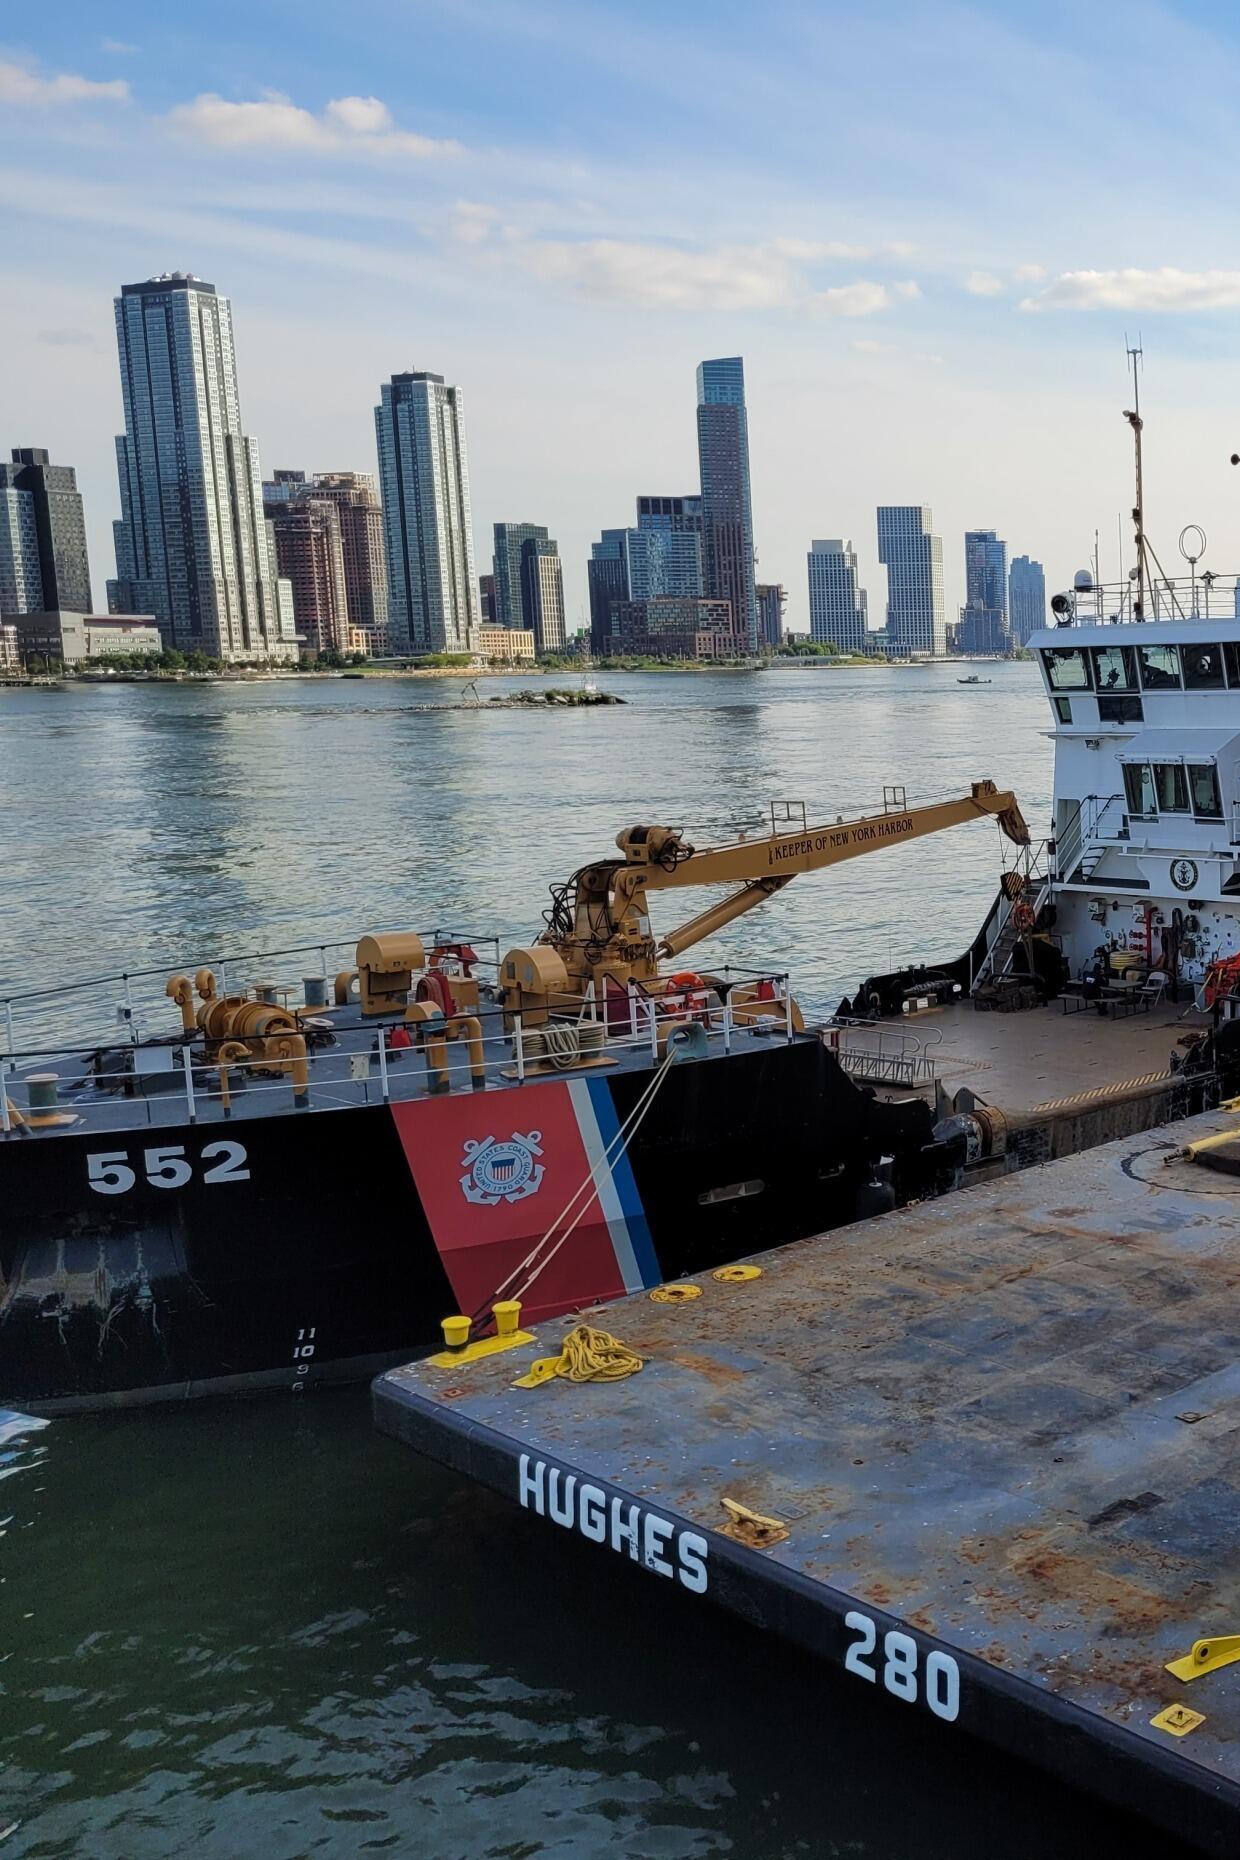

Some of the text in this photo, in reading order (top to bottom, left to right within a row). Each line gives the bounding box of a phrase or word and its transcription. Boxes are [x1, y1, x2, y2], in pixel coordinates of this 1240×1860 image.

[775, 818, 914, 860] KEEPER OF NEW YORK HARBOR
[86, 1140, 251, 1195] 552
[475, 1145, 531, 1189] UNITED STATES COAST GUARD
[493, 1184, 513, 1192] 1790
[293, 1344, 315, 1358] 10
[297, 1327, 316, 1340] 11
[296, 1363, 309, 1375] 9
[519, 1453, 708, 1594] HUGHES
[844, 1610, 960, 1723] 280
